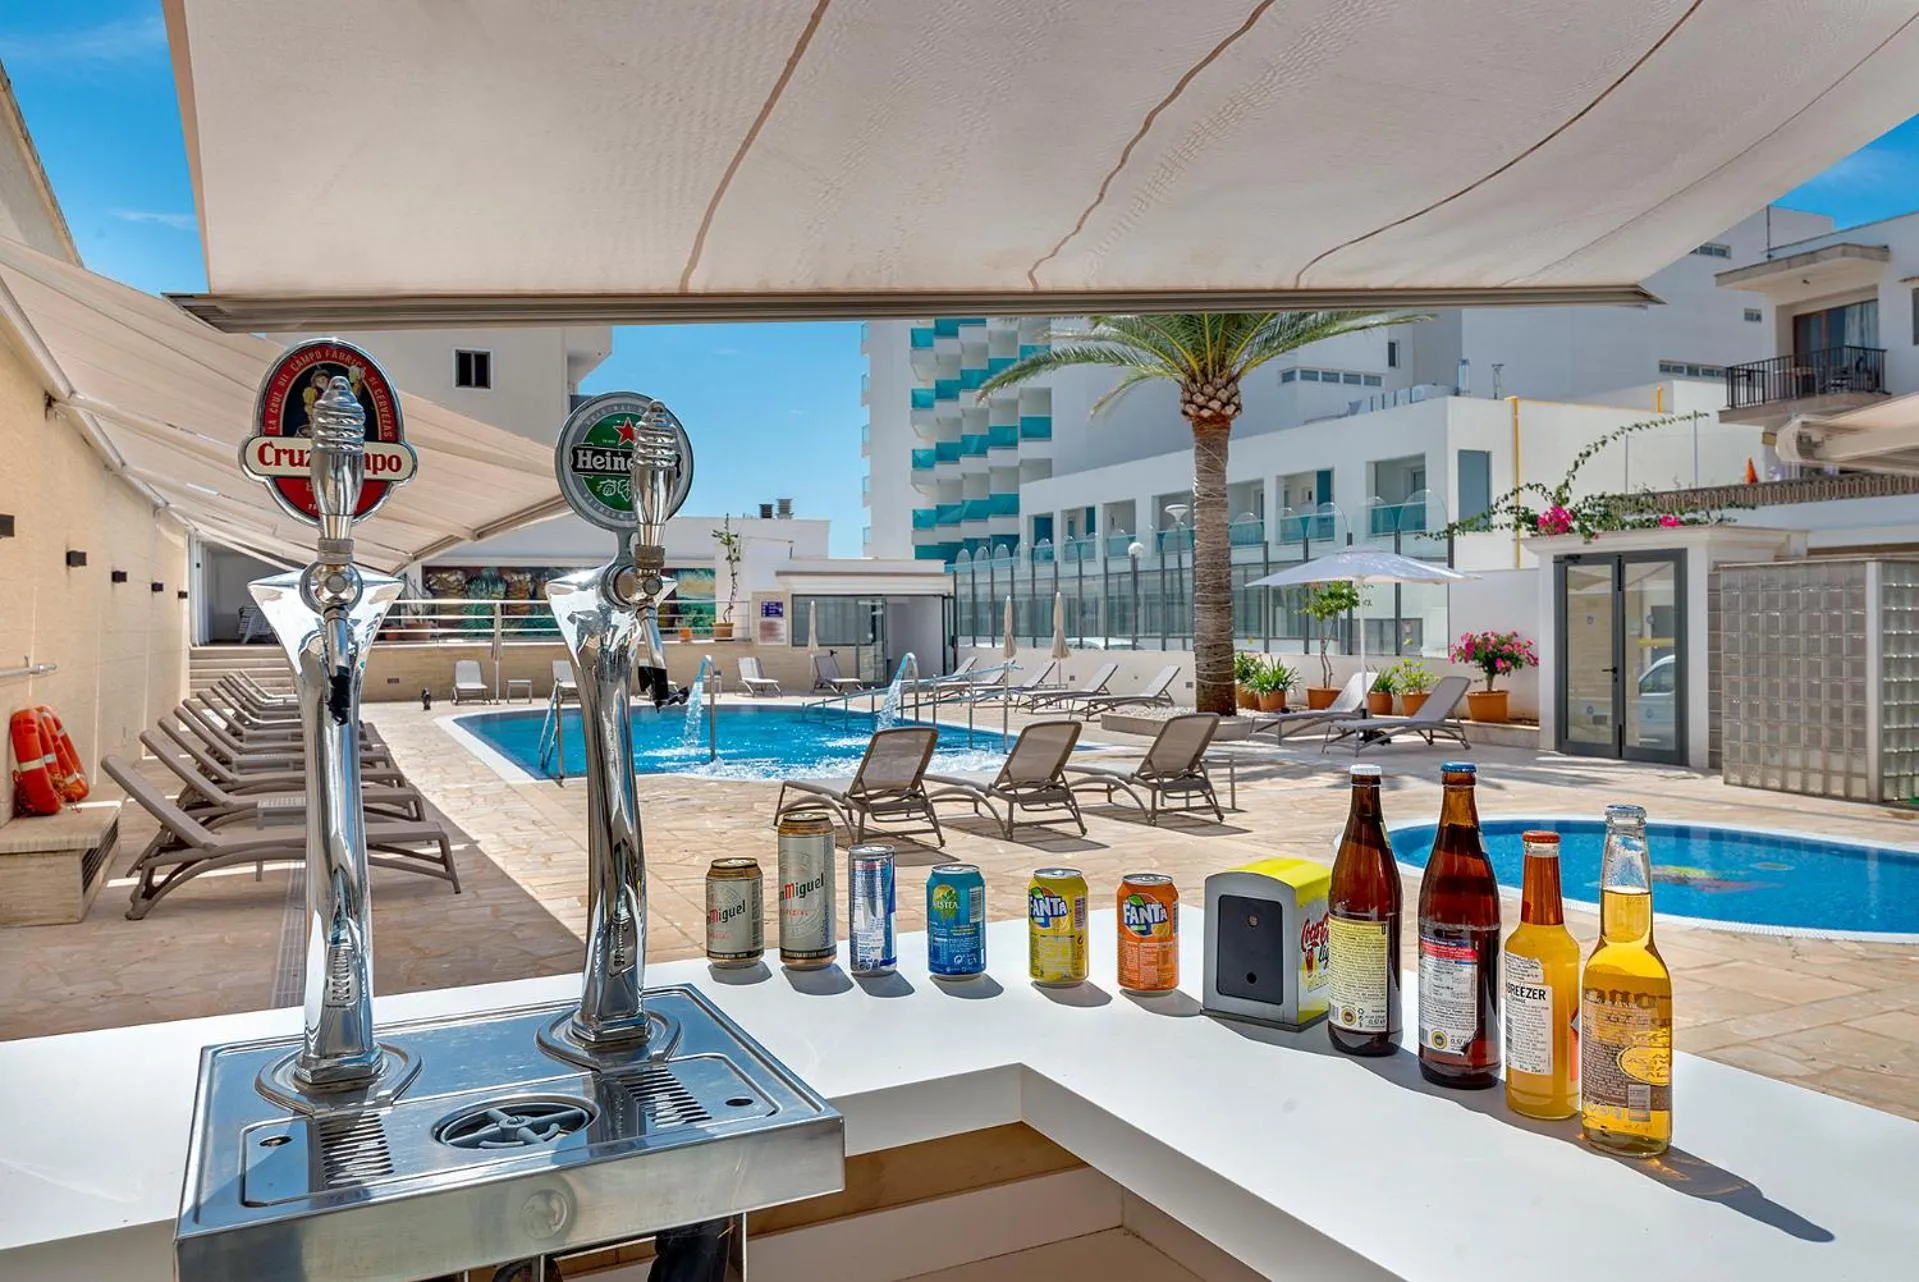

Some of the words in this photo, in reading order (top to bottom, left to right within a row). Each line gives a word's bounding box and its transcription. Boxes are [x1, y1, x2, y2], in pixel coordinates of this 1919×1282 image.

[576, 450, 635, 473] Heine
[784, 872, 824, 899] Miguel
[709, 899, 746, 924] Miguel
[1122, 901, 1168, 924] FANTA
